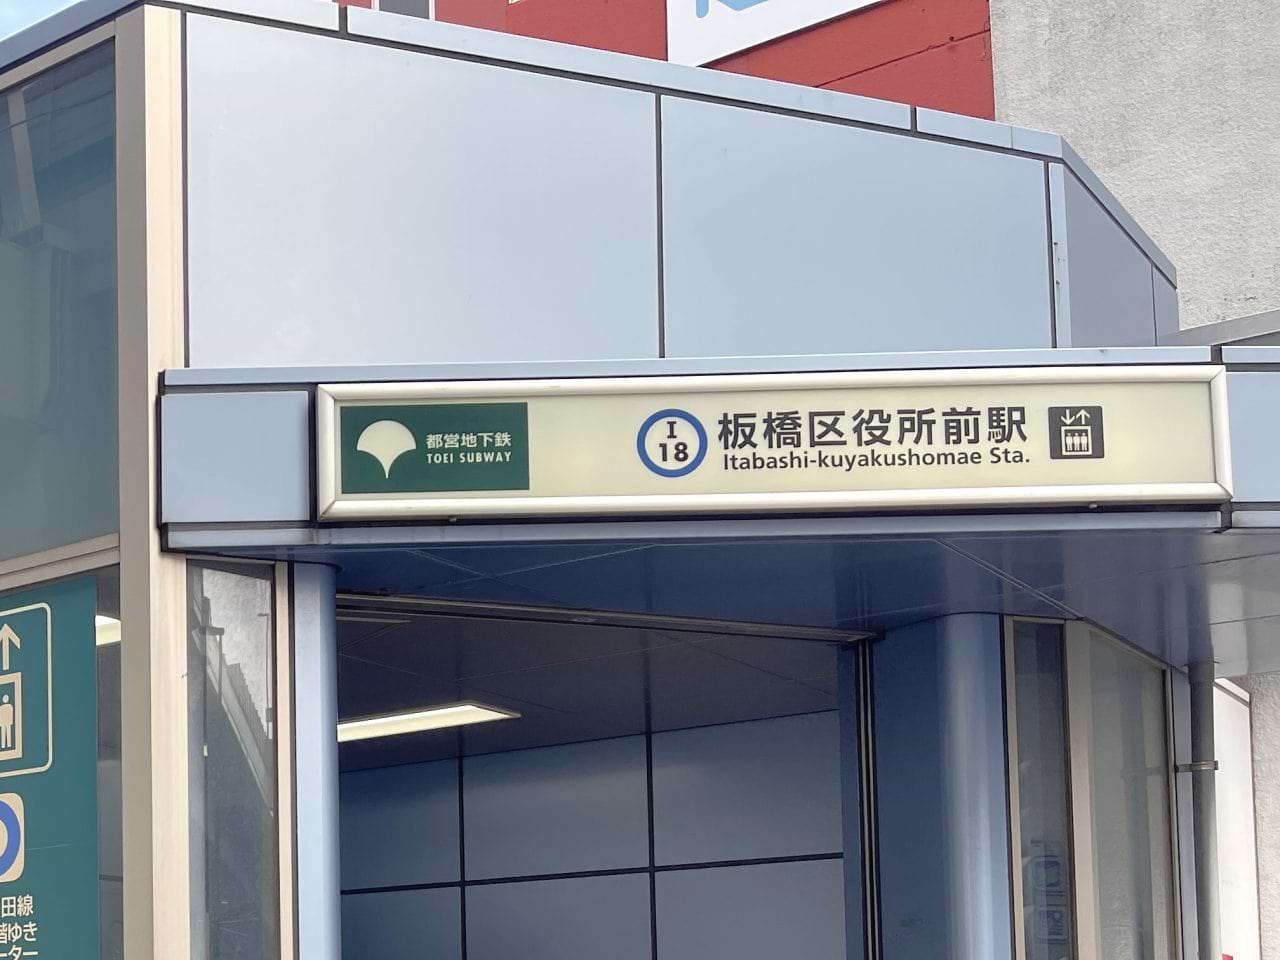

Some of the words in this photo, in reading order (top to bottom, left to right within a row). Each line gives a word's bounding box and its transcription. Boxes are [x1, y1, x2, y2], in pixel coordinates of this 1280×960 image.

[666, 421, 677, 438] I
[717, 406, 1028, 451] 板橋区役所前駅
[426, 431, 512, 449] 都営地下鉄
[426, 452, 454, 464] TOEI
[459, 451, 512, 464] SUBWAY
[657, 442, 690, 462] 18
[723, 448, 983, 472] Itabashi-kuyakushomae
[989, 447, 1030, 464] Sta.
